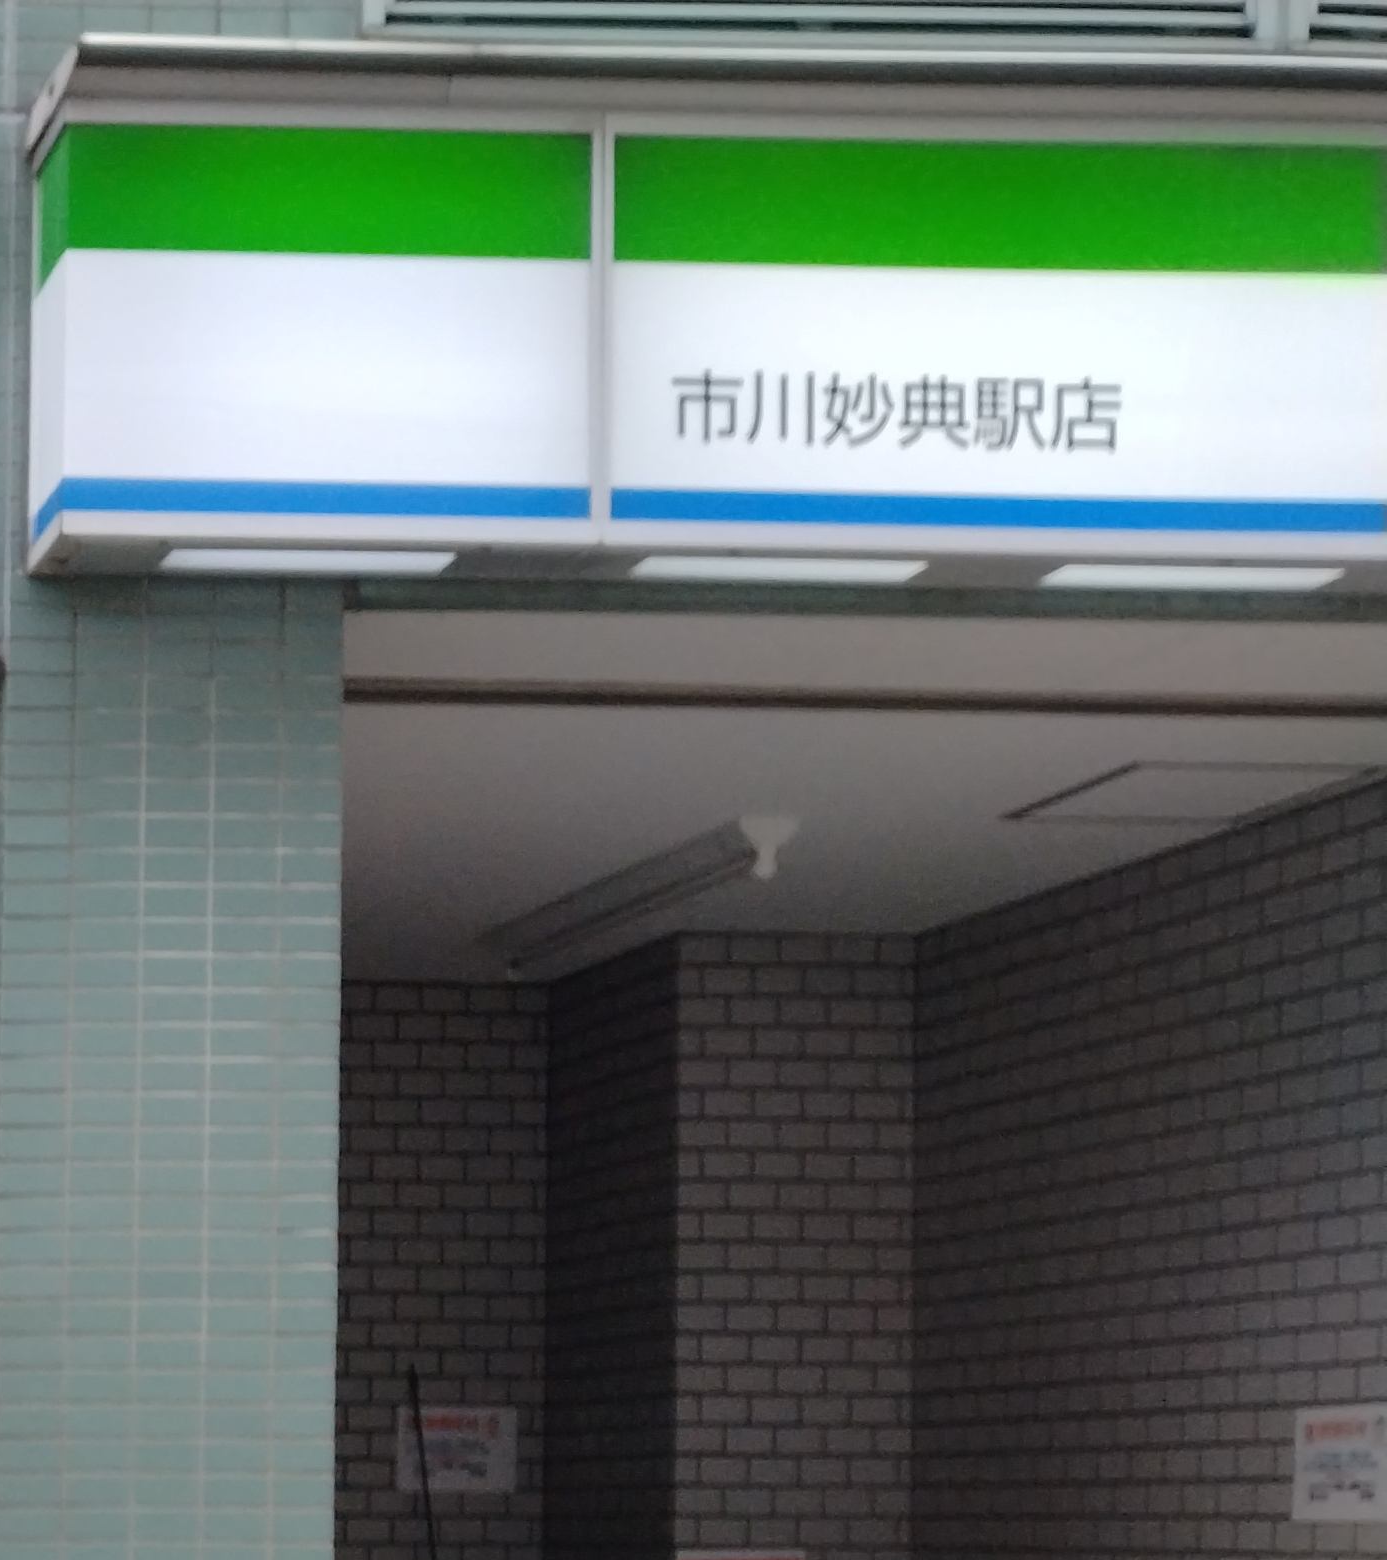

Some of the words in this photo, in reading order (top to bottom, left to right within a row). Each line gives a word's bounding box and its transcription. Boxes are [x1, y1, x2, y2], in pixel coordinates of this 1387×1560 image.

[671, 368, 1123, 453] 市川妙典駅店
